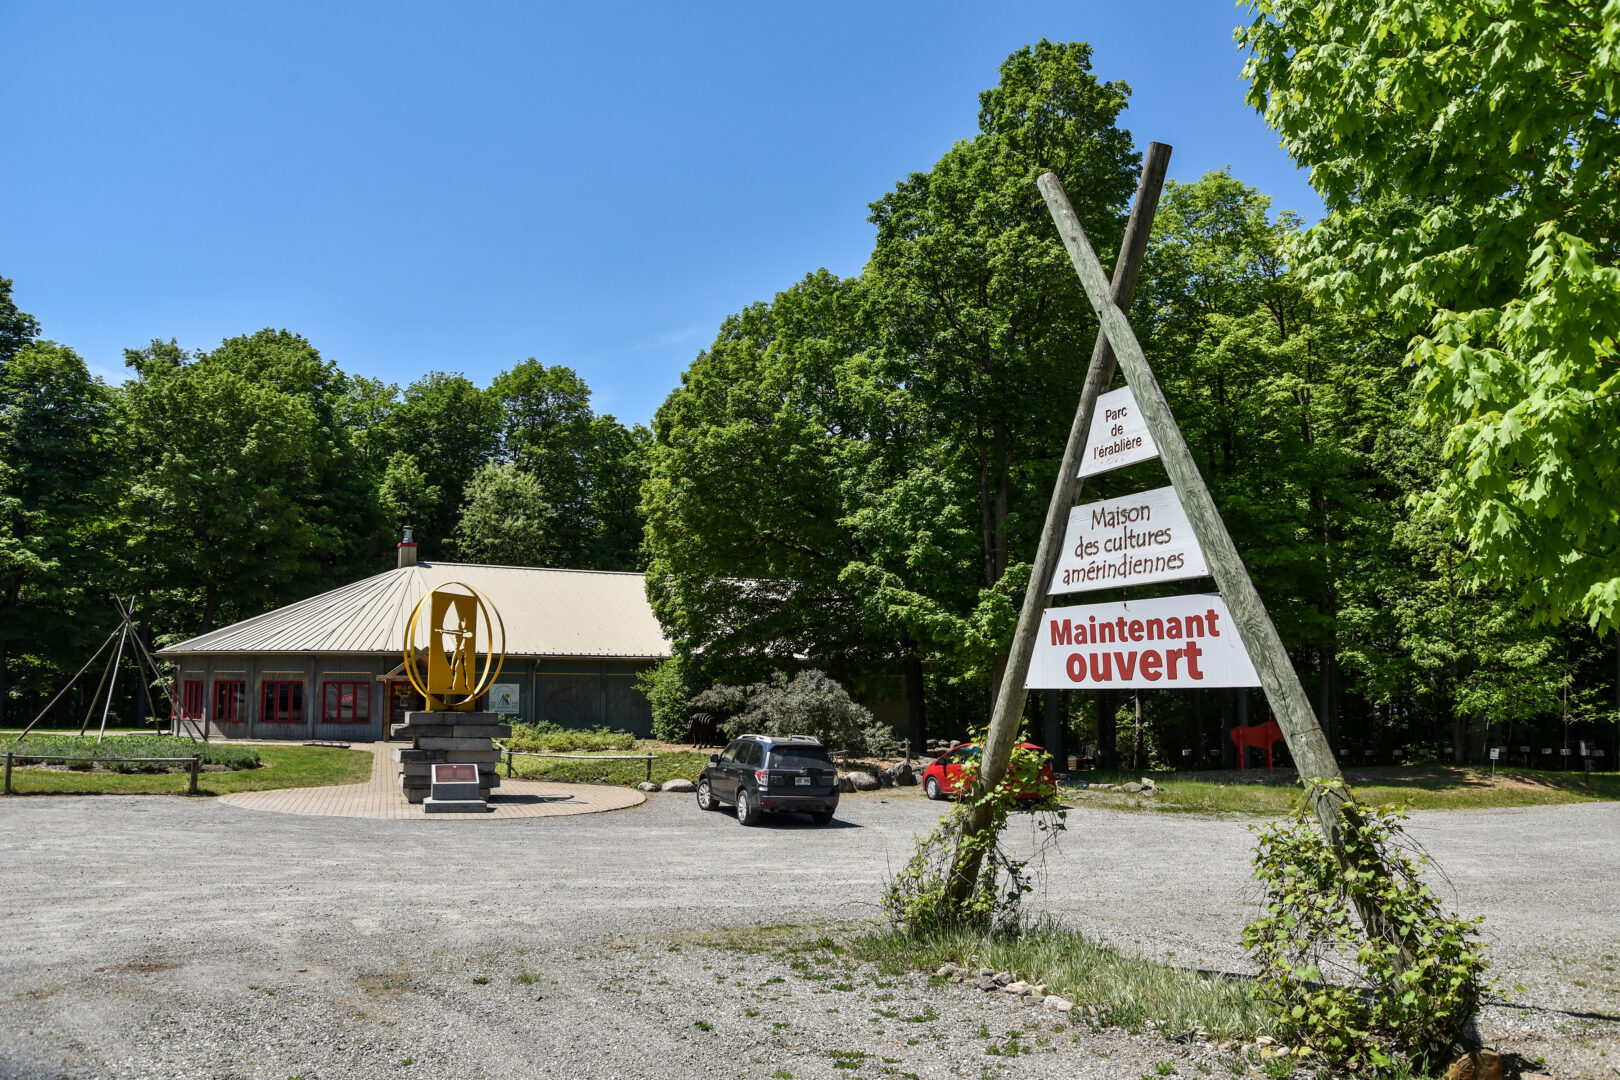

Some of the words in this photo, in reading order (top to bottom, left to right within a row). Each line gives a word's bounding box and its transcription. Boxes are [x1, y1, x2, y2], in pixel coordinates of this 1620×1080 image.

[1105, 406, 1127, 423] Parc
[1111, 423, 1123, 436] de
[1093, 436, 1142, 460] l'érablière
[1091, 505, 1150, 530] Maison
[1074, 536, 1099, 559] des
[1104, 525, 1171, 553] cultures
[1062, 552, 1184, 586] amérindiennes
[1050, 609, 1220, 646] Maintenant
[1066, 641, 1203, 683] ouvert
